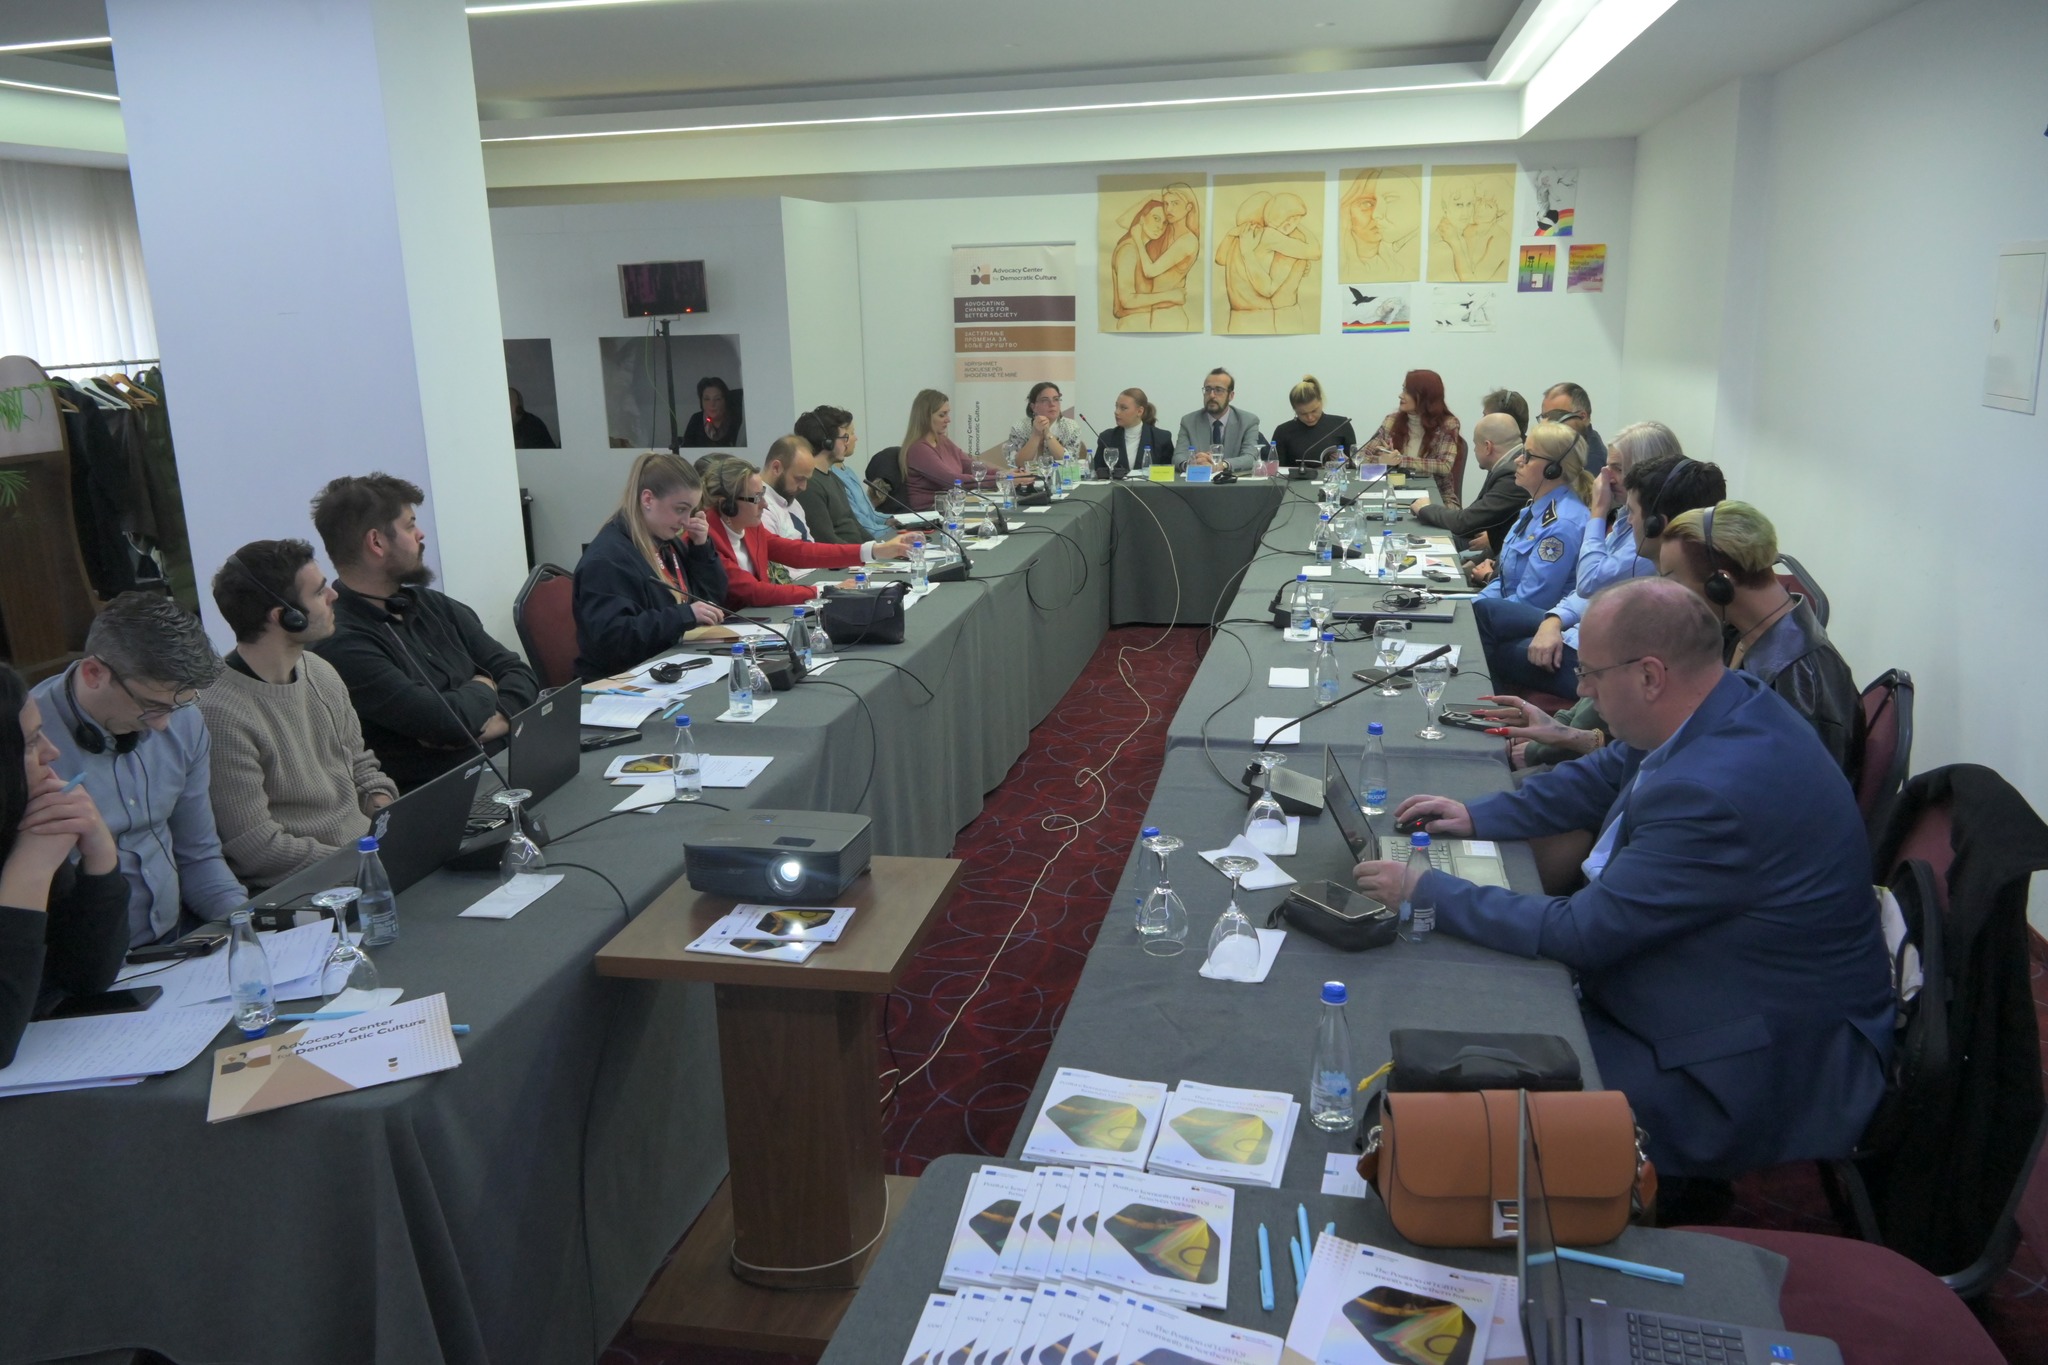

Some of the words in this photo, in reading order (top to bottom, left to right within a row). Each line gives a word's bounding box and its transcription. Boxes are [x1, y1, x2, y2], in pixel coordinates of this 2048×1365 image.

[277, 1031, 344, 1051] Advocacy
[348, 1019, 394, 1034] Center
[296, 1032, 374, 1055] Democratic
[377, 1019, 426, 1035] Culture
